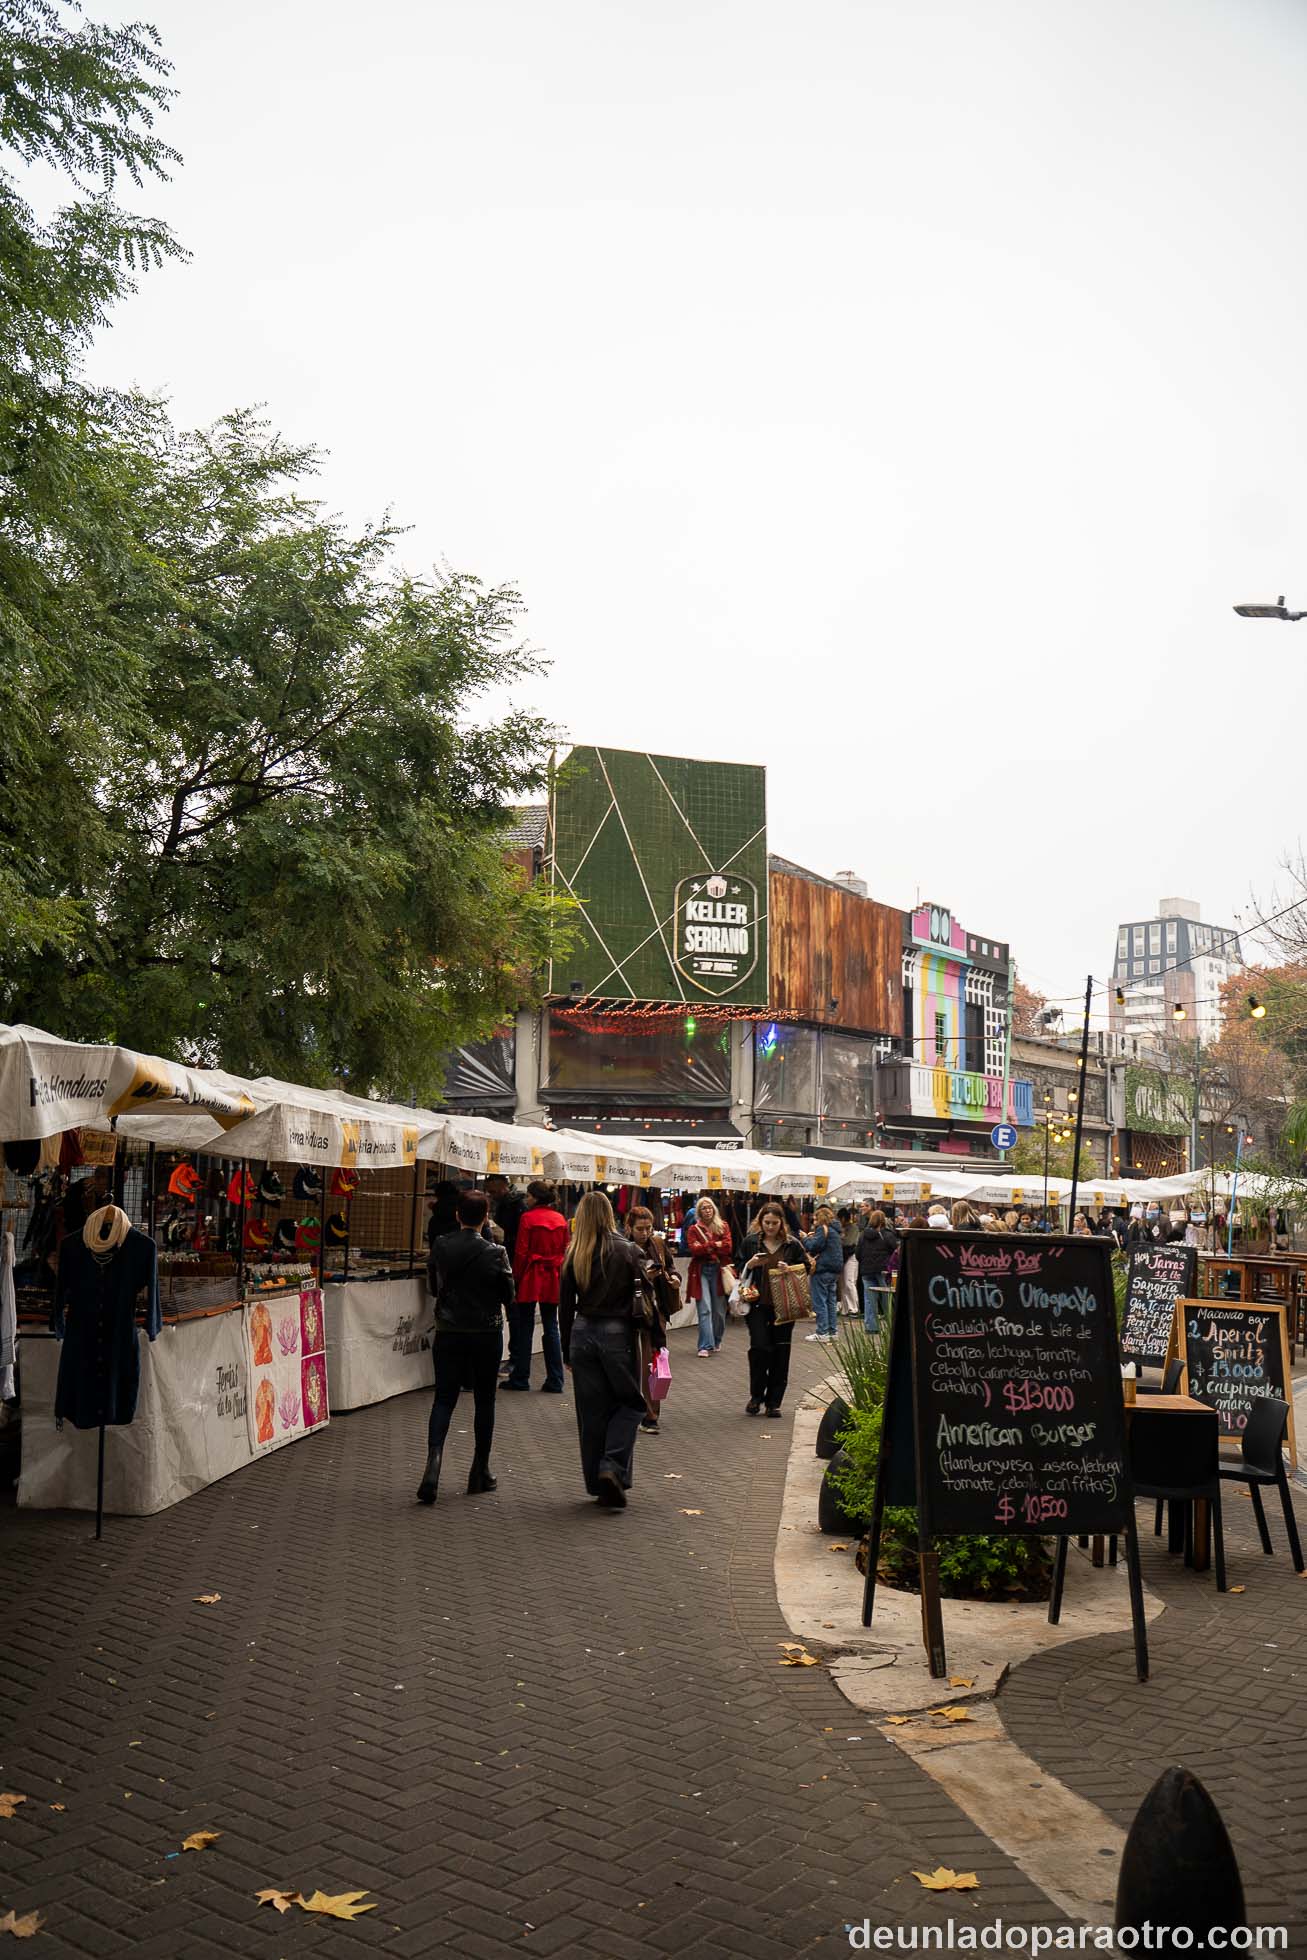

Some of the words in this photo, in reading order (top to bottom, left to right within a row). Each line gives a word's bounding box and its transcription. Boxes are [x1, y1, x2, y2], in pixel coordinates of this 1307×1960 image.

[685, 900, 748, 925] KELLER
[684, 925, 749, 955] SERRANO
[49, 1073, 108, 1104] Honduras
[964, 1079, 989, 1107] CLUB
[997, 1127, 1012, 1147] E
[1148, 1254, 1185, 1271] Jarras
[1026, 1321, 1044, 1336] de
[1076, 1328, 1093, 1339] de
[1187, 1319, 1201, 1339] 2
[1202, 1320, 1268, 1347] Aperol
[1212, 1342, 1265, 1366] Spritz
[1190, 1378, 1203, 1396] 2
[936, 1413, 1024, 1450] American
[1030, 1423, 1097, 1447] Burger
[1046, 1478, 1068, 1491] con
